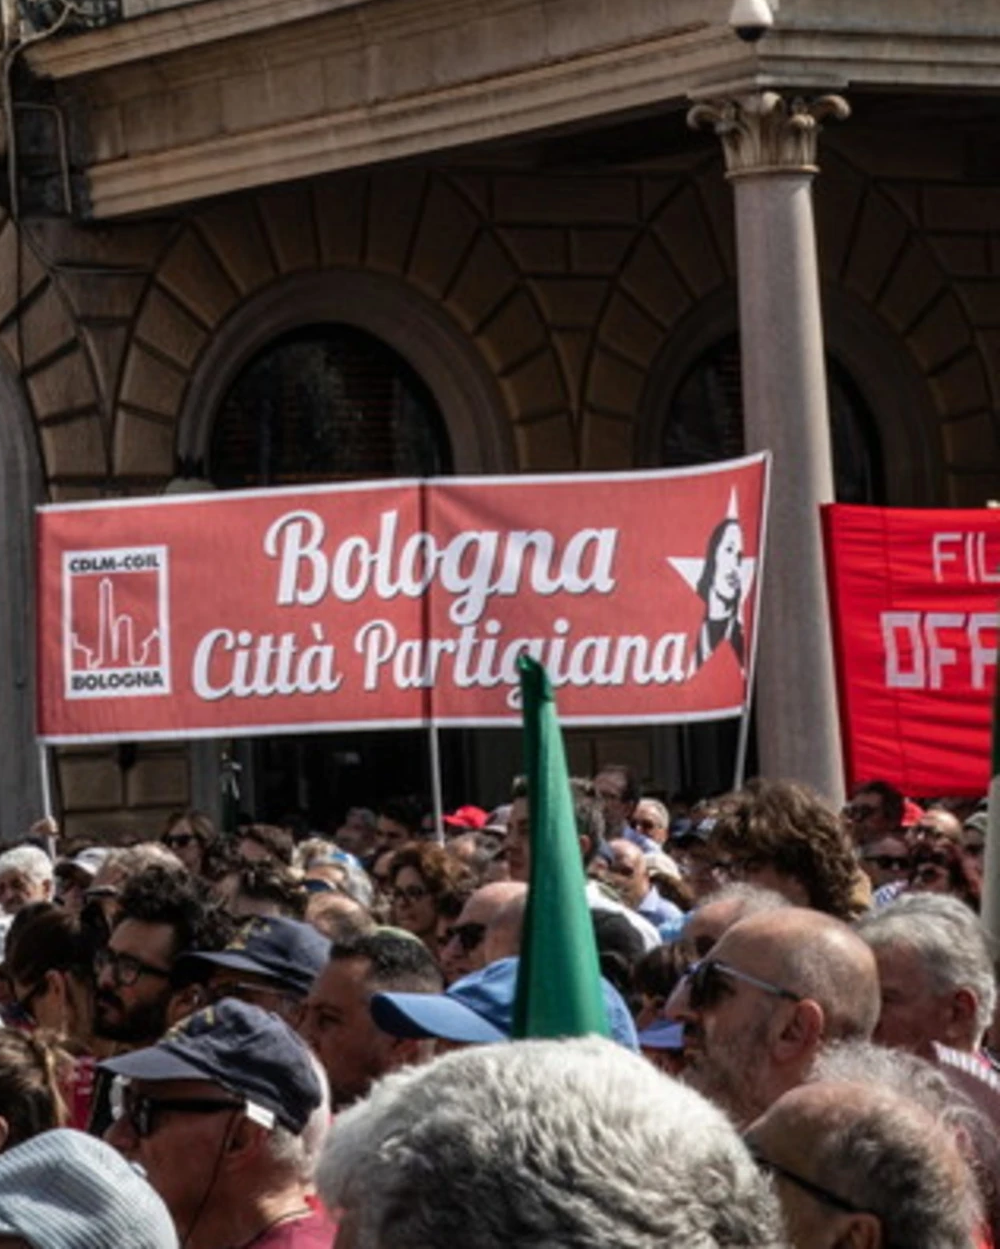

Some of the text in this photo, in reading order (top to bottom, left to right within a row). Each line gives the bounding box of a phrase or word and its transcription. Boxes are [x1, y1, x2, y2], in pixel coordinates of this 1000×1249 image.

[264, 509, 619, 625] Bologna
[71, 671, 164, 691] BOLOGNA
[192, 622, 344, 701] Città
